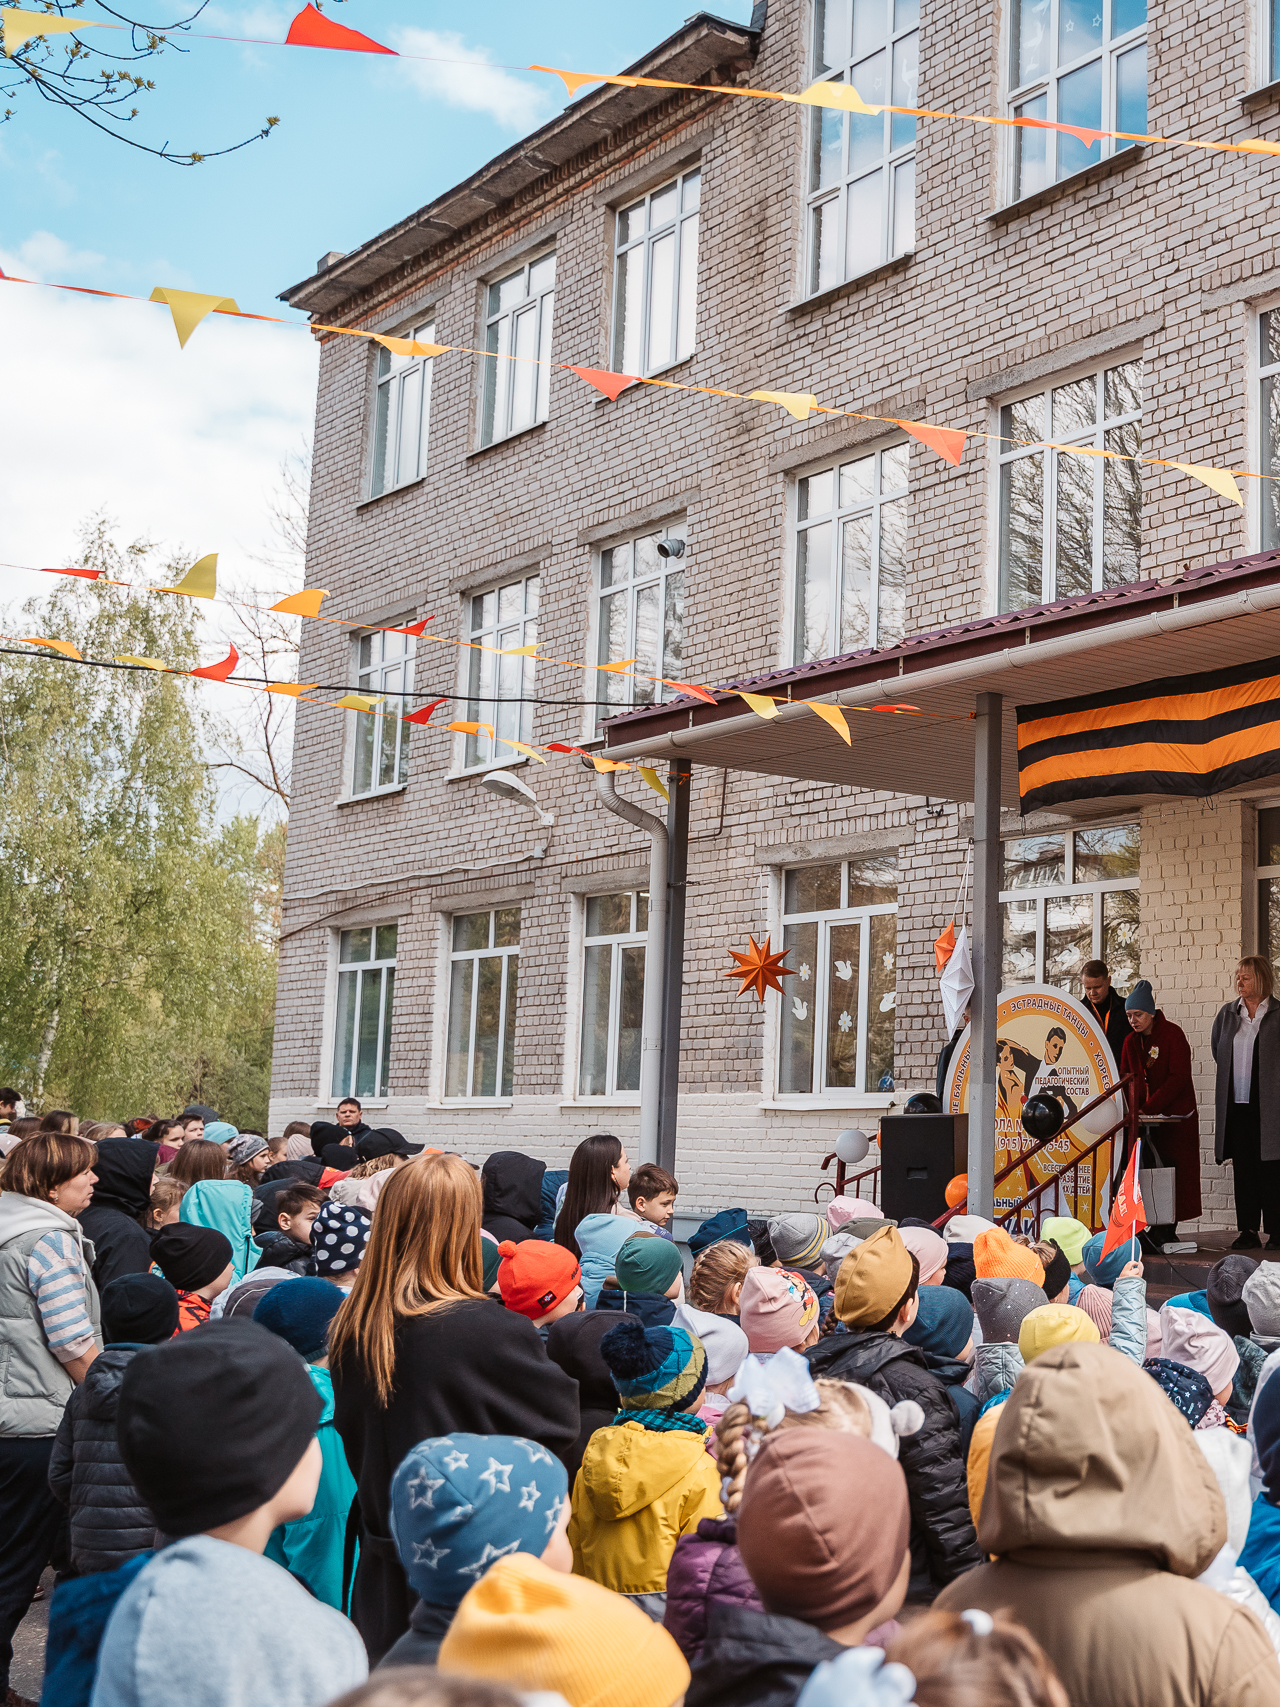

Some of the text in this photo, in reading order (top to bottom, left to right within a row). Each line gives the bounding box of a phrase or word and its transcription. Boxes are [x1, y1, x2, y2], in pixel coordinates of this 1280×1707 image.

[1010, 998, 1090, 1038] ЭСТРАДНЫЕ ТАНЦЫ
[953, 1044, 971, 1099] БАЛЬНЫ
[1057, 1065, 1090, 1075] ОПЫТНЫЙ
[1094, 1050, 1111, 1092] ХОРЕО
[1034, 1076, 1090, 1086] ПЕДАГОГИЧЕСКИЙ
[1066, 1087, 1090, 1096] СОСТАВ
[997, 1136, 1021, 1151] (915)
